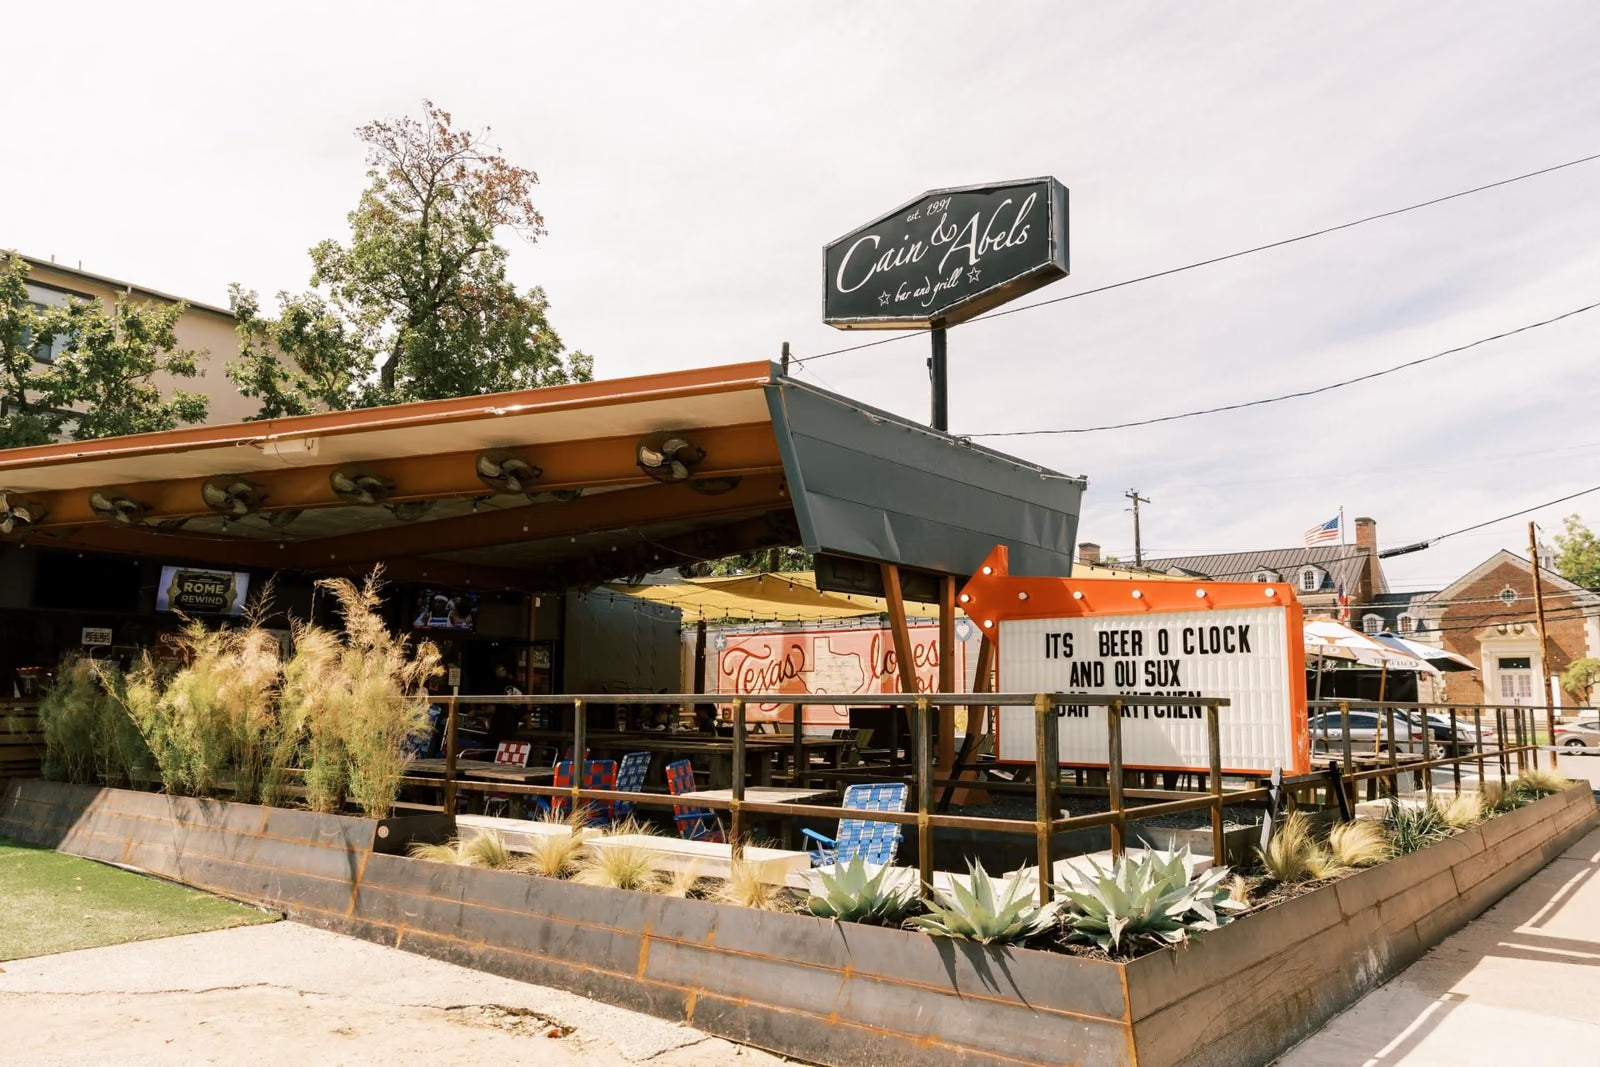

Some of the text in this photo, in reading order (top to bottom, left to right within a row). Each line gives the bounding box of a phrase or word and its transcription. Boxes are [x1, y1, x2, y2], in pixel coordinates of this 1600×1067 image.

[906, 197, 951, 222] est. 1991
[836, 192, 1037, 293] Cain & Abels
[894, 266, 963, 307] bar and grill
[181, 594, 223, 606] REWIND
[183, 582, 224, 595] ROME
[1045, 624, 1251, 659] ITS BEER O CLOCK
[722, 633, 940, 711] Texas loes
[1070, 660, 1181, 687] AND OU SUX
